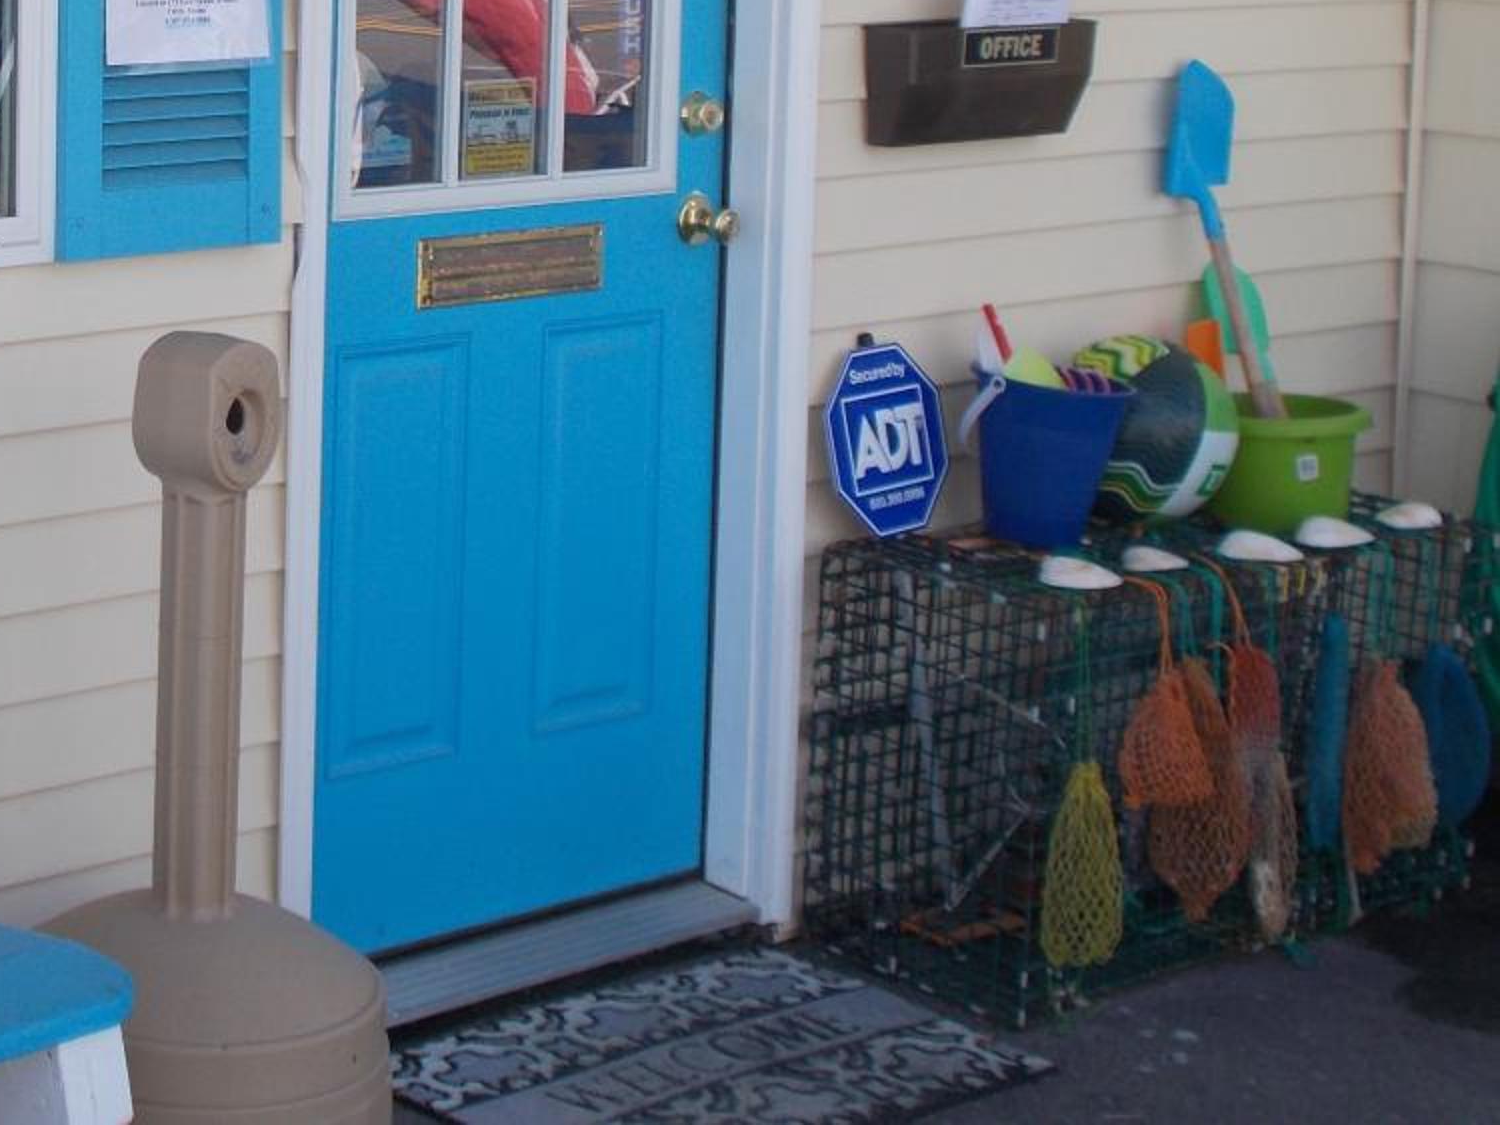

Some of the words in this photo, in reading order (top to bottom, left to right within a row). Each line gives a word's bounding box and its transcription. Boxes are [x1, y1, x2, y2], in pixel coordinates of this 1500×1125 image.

[980, 34, 1044, 60] OFFICE
[849, 364, 891, 386] Secured
[890, 361, 906, 379] by
[855, 404, 925, 479] ADT
[545, 1009, 860, 1114] WELCOME
